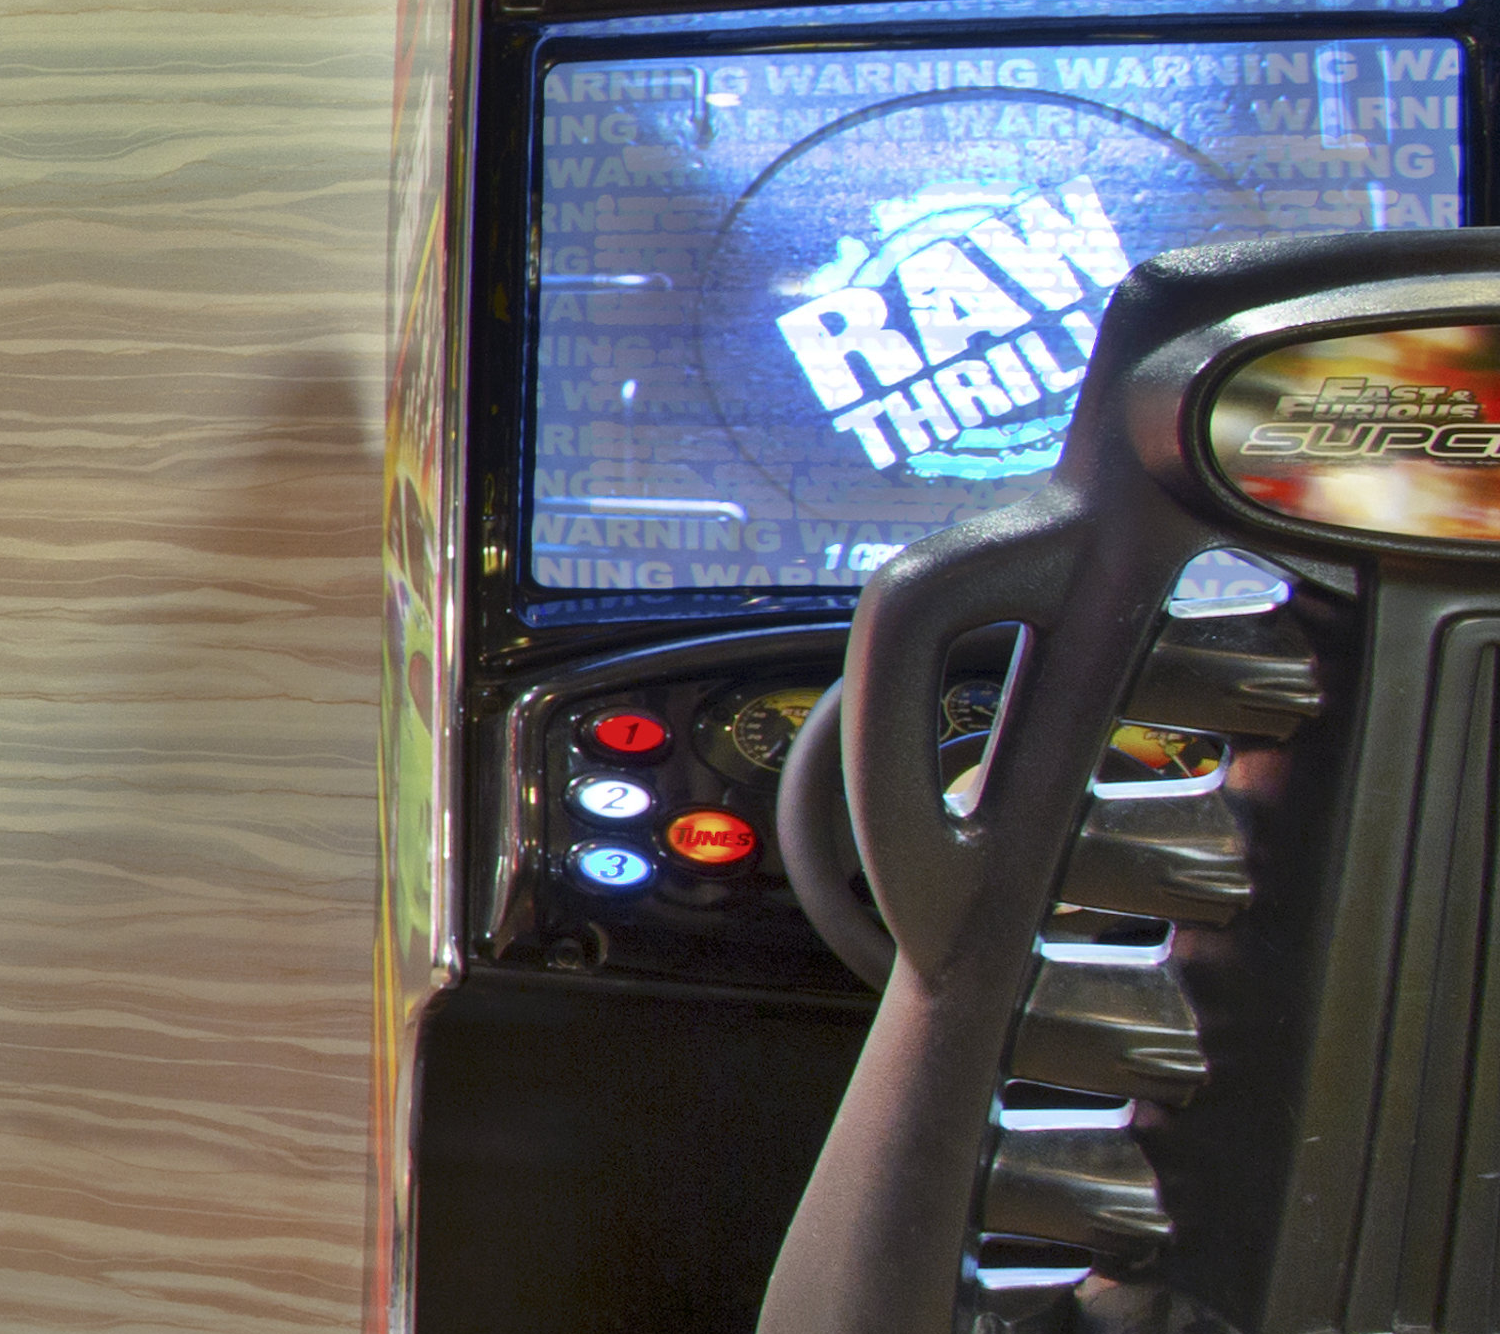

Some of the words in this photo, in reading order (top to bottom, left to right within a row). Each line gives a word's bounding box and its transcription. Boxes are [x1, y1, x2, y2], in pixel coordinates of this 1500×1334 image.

[544, 66, 751, 104] ARNING
[764, 56, 1038, 99] WARNING
[1055, 50, 1358, 90] WARNING
[1254, 96, 1459, 133] WARNI
[776, 174, 1132, 409] RAW
[832, 305, 1097, 468] THRIL
[1318, 376, 1450, 404] FAST
[1275, 394, 1482, 420] FURIOUS
[1240, 421, 1500, 458] SUPE
[539, 556, 674, 589] NING
[625, 721, 641, 744] 1
[602, 786, 629, 810] 2
[674, 825, 751, 849] TUNES
[601, 854, 627, 880] 3
